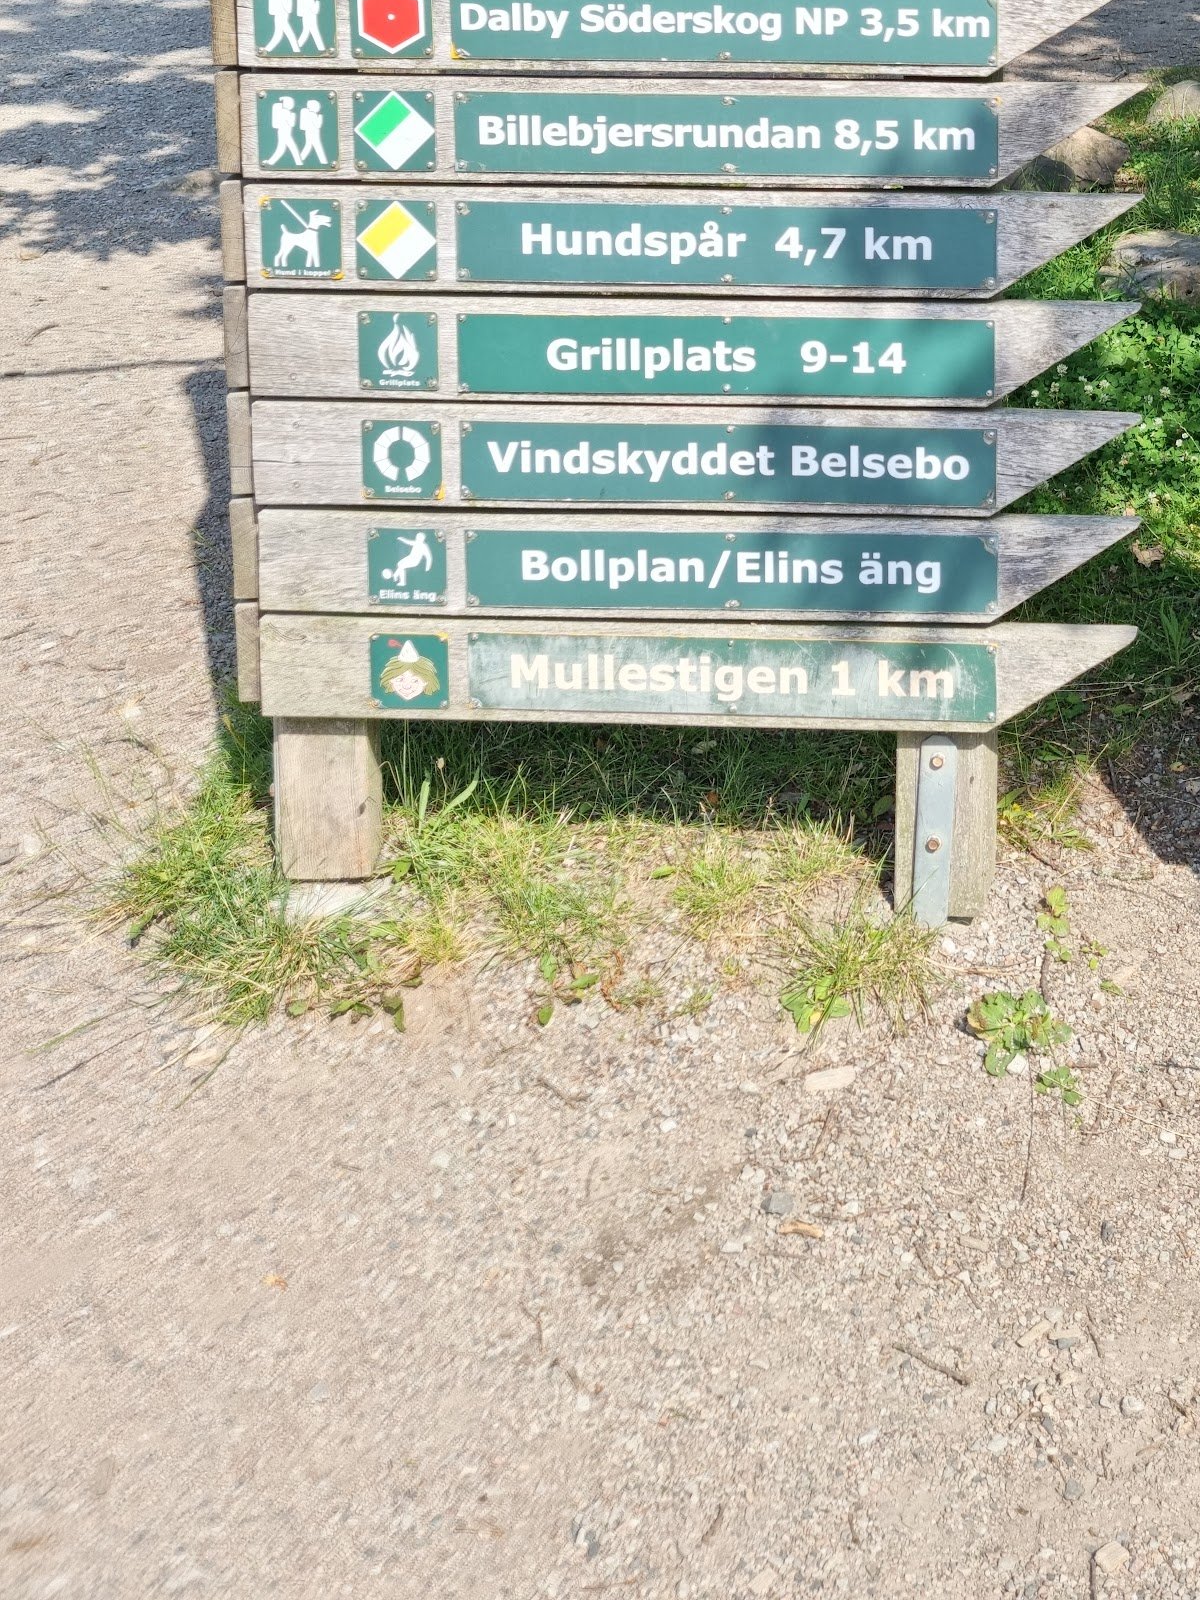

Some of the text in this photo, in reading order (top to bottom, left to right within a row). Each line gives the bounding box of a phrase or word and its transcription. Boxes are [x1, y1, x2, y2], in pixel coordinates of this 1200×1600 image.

[460, 3, 989, 42] Dalby Söderskog NP 3,5 km
[479, 115, 974, 156] Billebjersrundan 8,5 km
[522, 221, 932, 266] Hundspår 4,7 km
[547, 338, 906, 379] Grillplats 9-14
[379, 379, 420, 387] Grillplats
[487, 441, 969, 482] Vindskyddet Belsebo
[385, 486, 422, 494] Belsebo
[522, 549, 941, 593] Bollplan/Elins äng
[380, 590, 437, 602] Elins äng
[509, 654, 954, 701] Mullestigen 1 km
